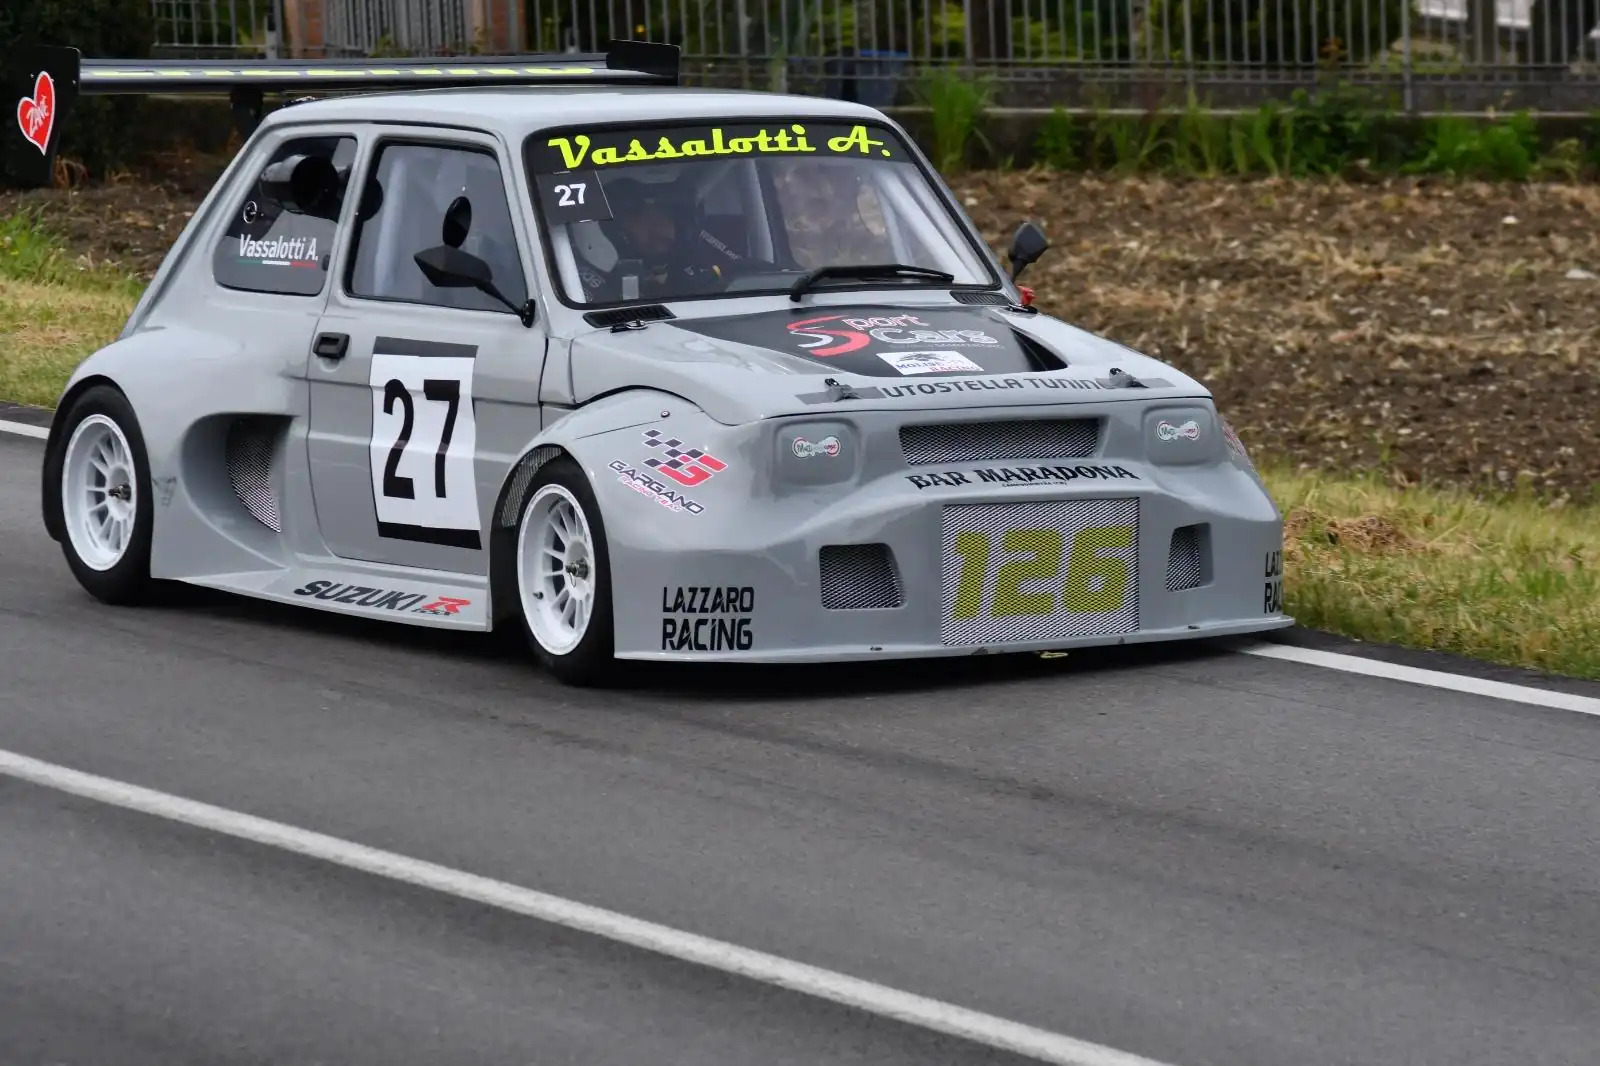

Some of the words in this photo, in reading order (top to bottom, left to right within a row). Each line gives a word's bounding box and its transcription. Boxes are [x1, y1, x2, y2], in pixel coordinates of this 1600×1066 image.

[548, 124, 816, 168] Vassalotti
[828, 125, 891, 157] A.
[554, 183, 587, 207] 27
[240, 233, 305, 259] Vassalotti
[305, 237, 318, 261] A.
[869, 327, 998, 344] Cars
[383, 378, 461, 500] 27
[608, 460, 704, 514] GARGANO
[905, 471, 971, 490] BAR
[974, 465, 1141, 483] MARADONA
[950, 523, 1134, 620] 126
[293, 580, 428, 611] SUZUKI
[662, 586, 755, 613] LAZZARO
[662, 618, 753, 651] RACING
